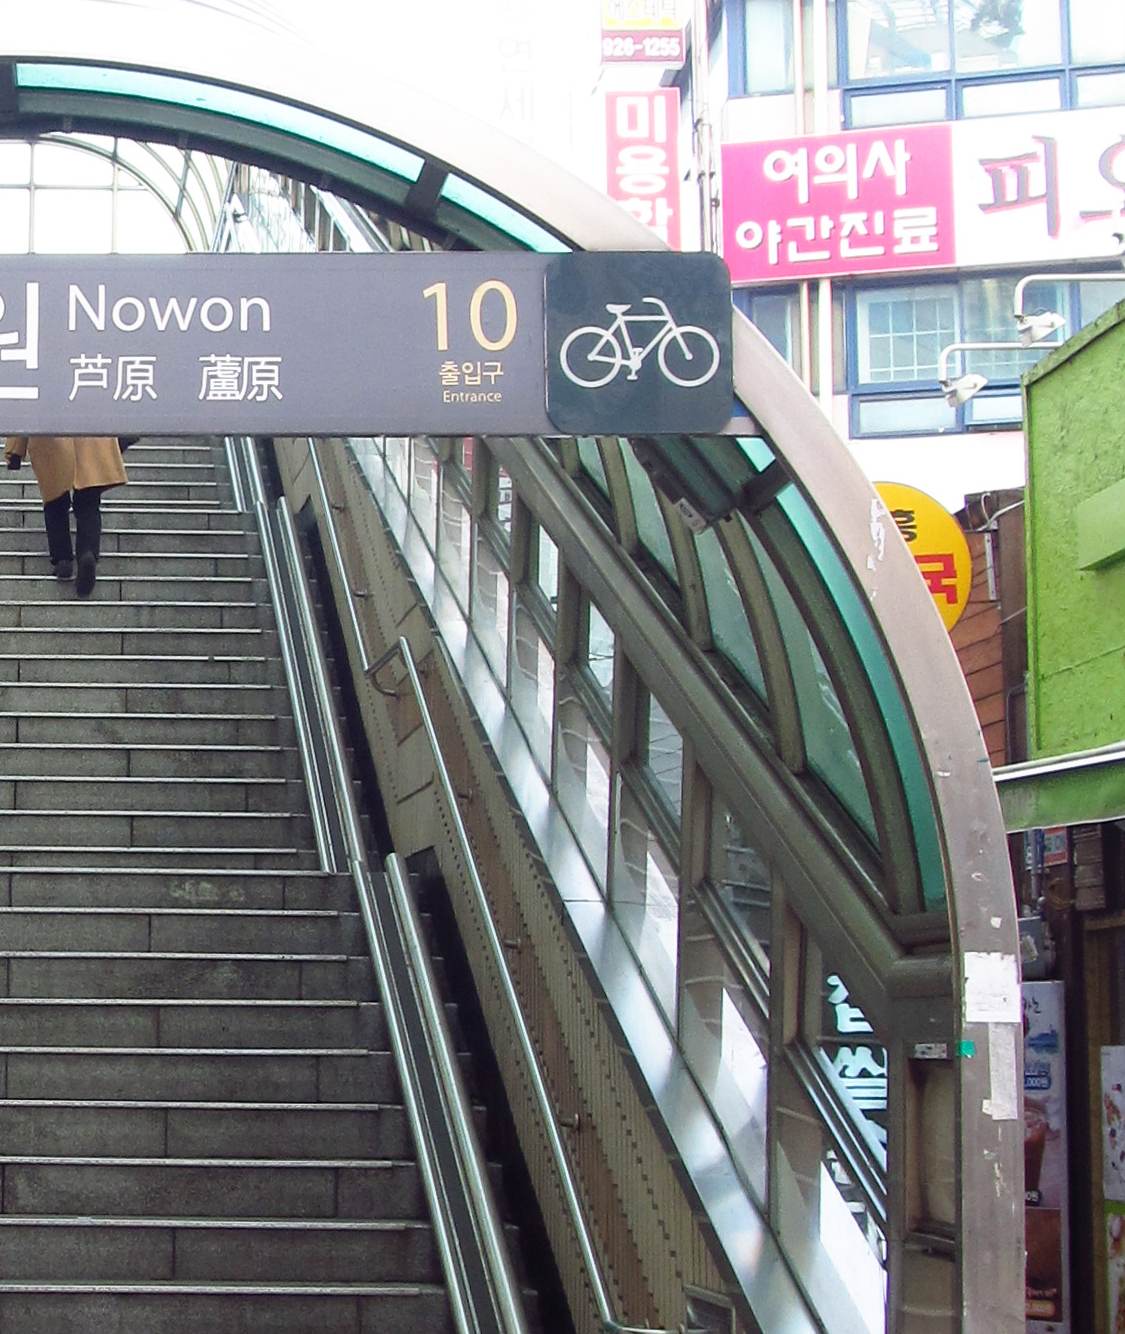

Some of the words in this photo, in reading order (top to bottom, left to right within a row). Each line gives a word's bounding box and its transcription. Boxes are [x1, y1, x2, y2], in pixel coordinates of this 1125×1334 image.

[602, 37, 680, 57] 926-1255
[763, 139, 910, 204] 여의사
[736, 206, 939, 265] 야간진료
[69, 283, 271, 332] Nowon
[422, 278, 518, 351] 10
[69, 354, 157, 401] 芦原
[198, 354, 282, 401] 蘆原
[439, 361, 504, 386] 출입구
[442, 390, 502, 403] Entrance
